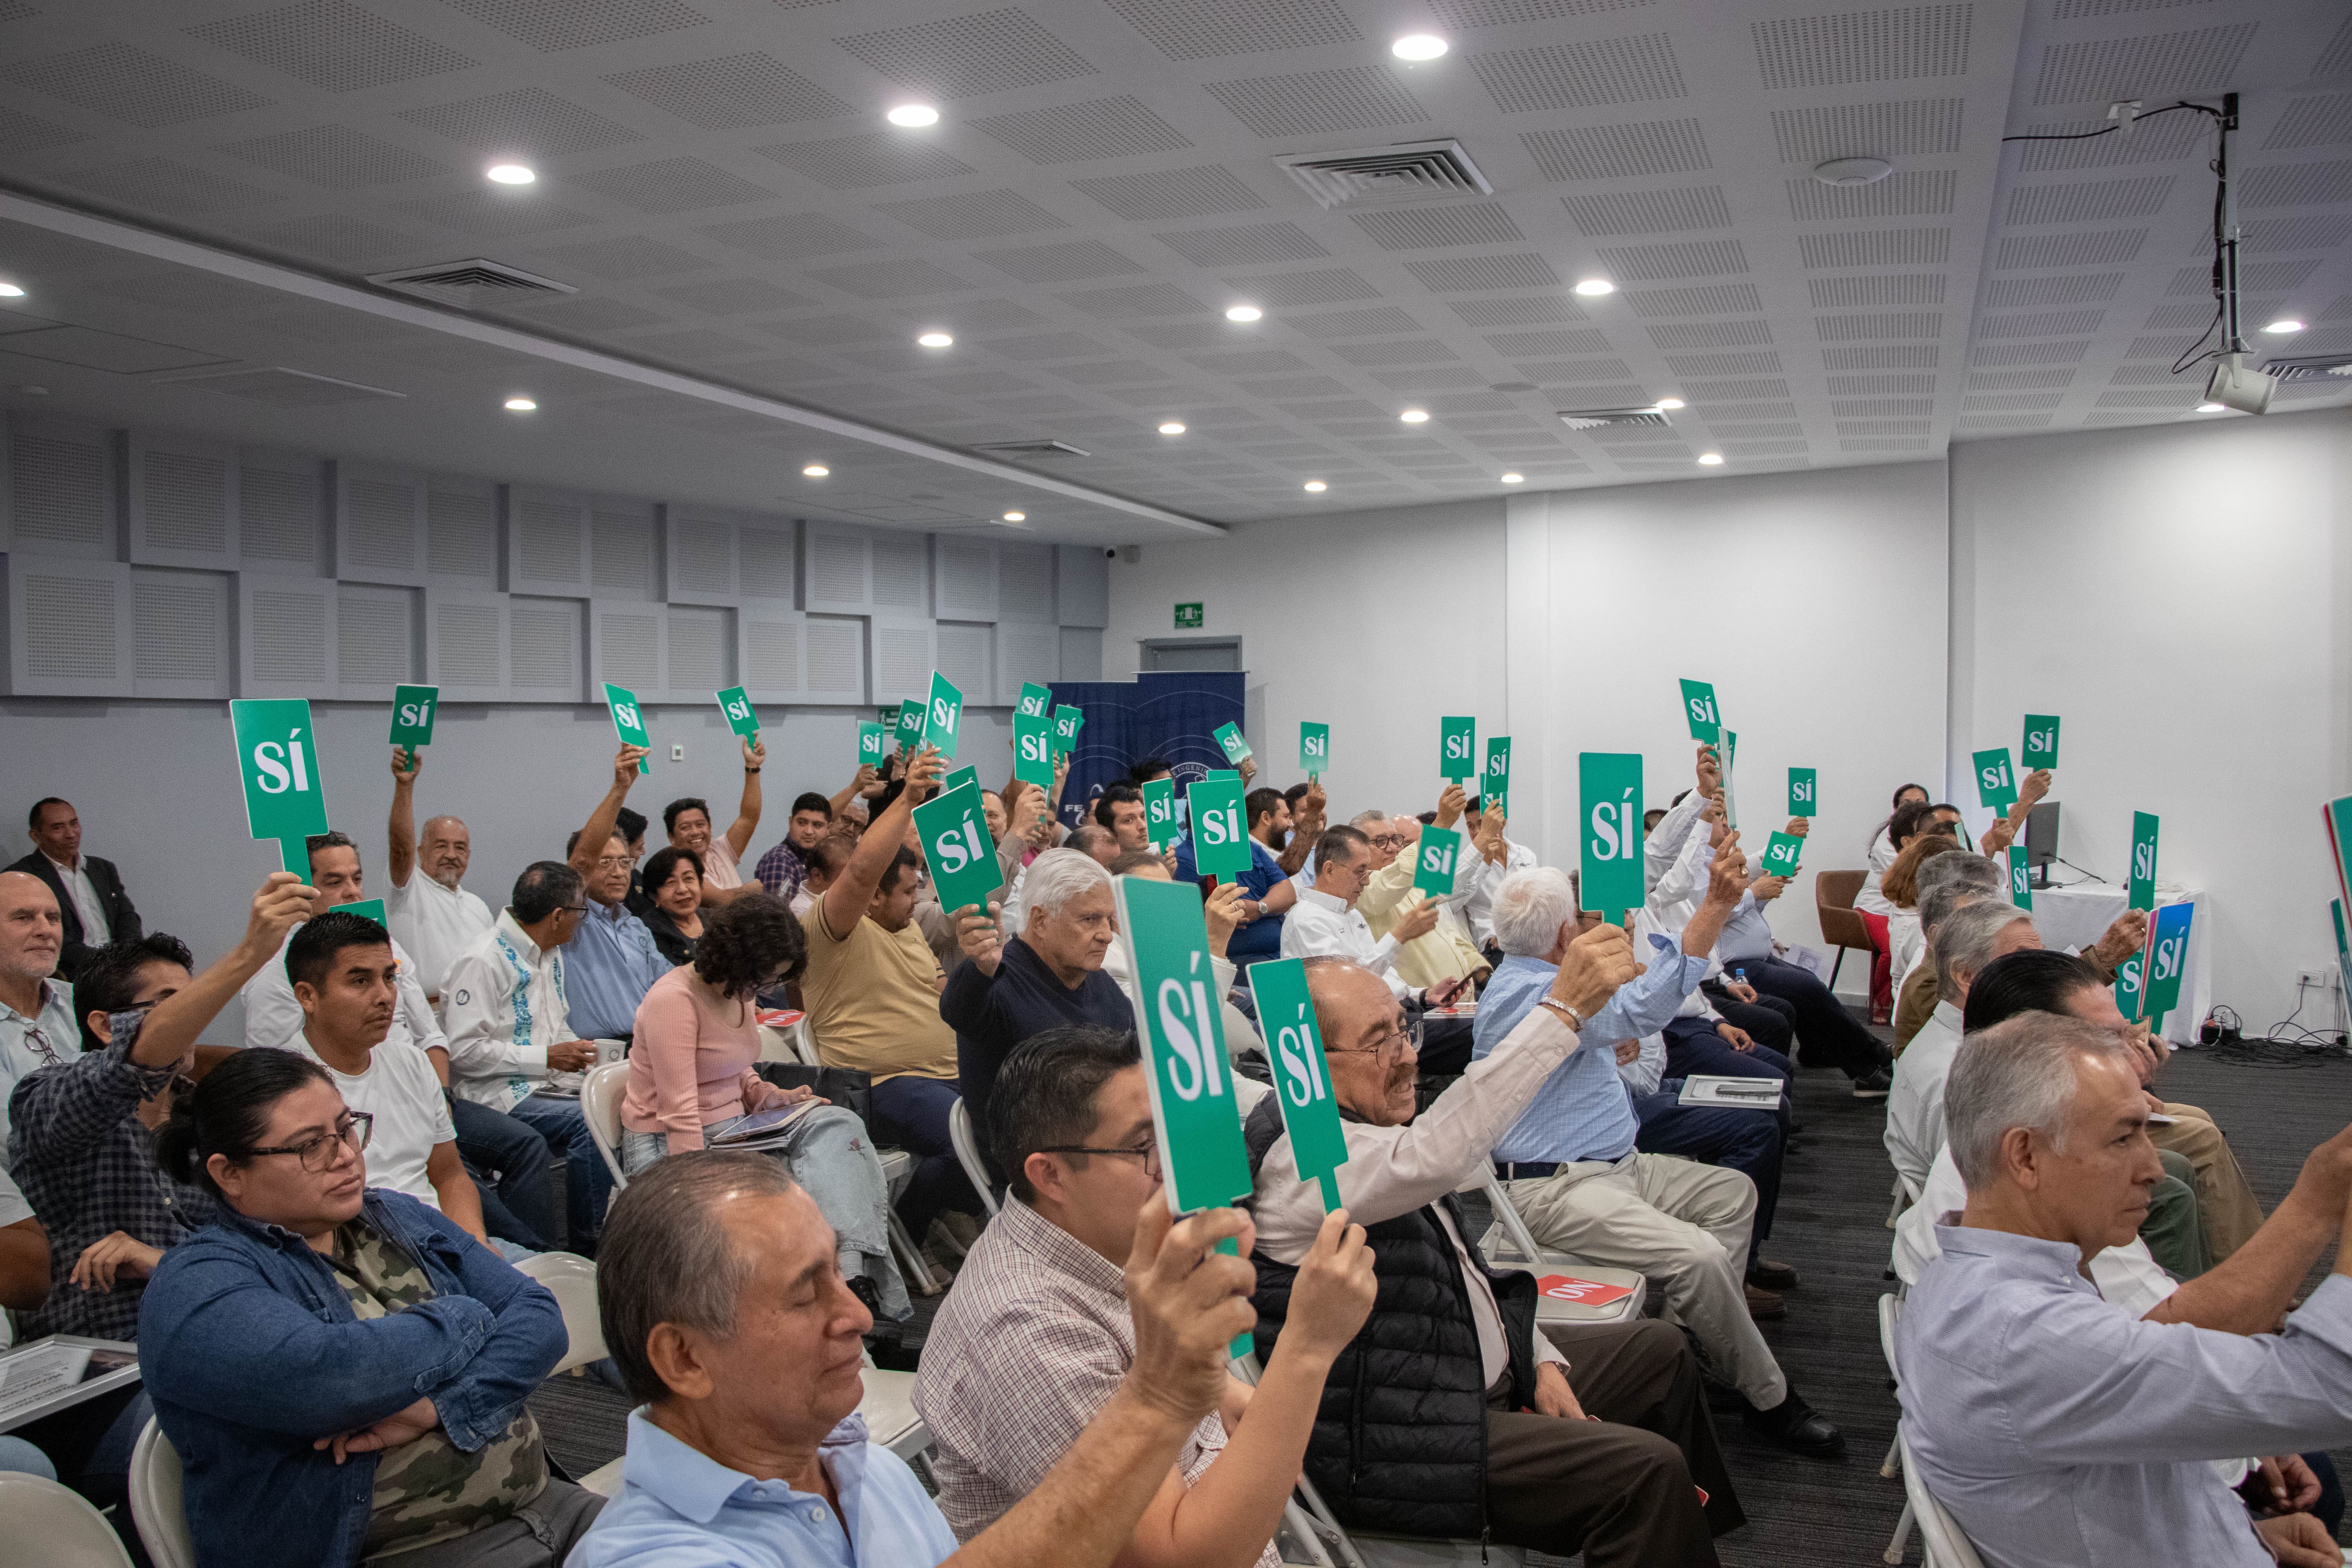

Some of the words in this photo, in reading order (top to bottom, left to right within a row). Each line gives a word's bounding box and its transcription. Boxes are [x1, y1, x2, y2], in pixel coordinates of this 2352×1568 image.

[399, 699, 430, 727] SÍ
[617, 701, 641, 730] SÍ
[728, 697, 750, 720] SÍ
[902, 712, 924, 731] SÍ
[933, 698, 957, 734] SÍ
[1021, 697, 1045, 717] SÍ
[1690, 696, 1715, 724] SÍ
[1057, 717, 1076, 737] SÍ
[1223, 730, 1242, 752] SÍ
[2029, 727, 2053, 753] SÍ
[863, 732, 880, 753] SÍ
[1021, 731, 1047, 762] SÍ
[1305, 734, 1325, 757] SÍ
[1446, 730, 1470, 759] SÍ
[254, 728, 309, 794] SÍ
[1178, 765, 1207, 774] INGENIE
[1490, 748, 1507, 776] SÍ
[1982, 760, 2009, 789] SÍ
[1793, 779, 1812, 802] SÍ
[1150, 792, 1171, 823] SÍ
[1202, 799, 1240, 845] SÍ
[1592, 787, 1634, 861] SÍ
[936, 808, 984, 873] SÍ
[1771, 844, 1796, 863] SÍ
[1422, 844, 1454, 875] SÍ
[2135, 836, 2154, 881] SÍ
[2014, 862, 2029, 894] SÍ
[2154, 926, 2185, 980] SÍ
[2122, 960, 2143, 993] S
[764, 1012, 801, 1024] NO
[1158, 951, 1223, 1102] SÍ
[1278, 1003, 1326, 1107] SÍ
[1546, 1280, 1605, 1298] NO
